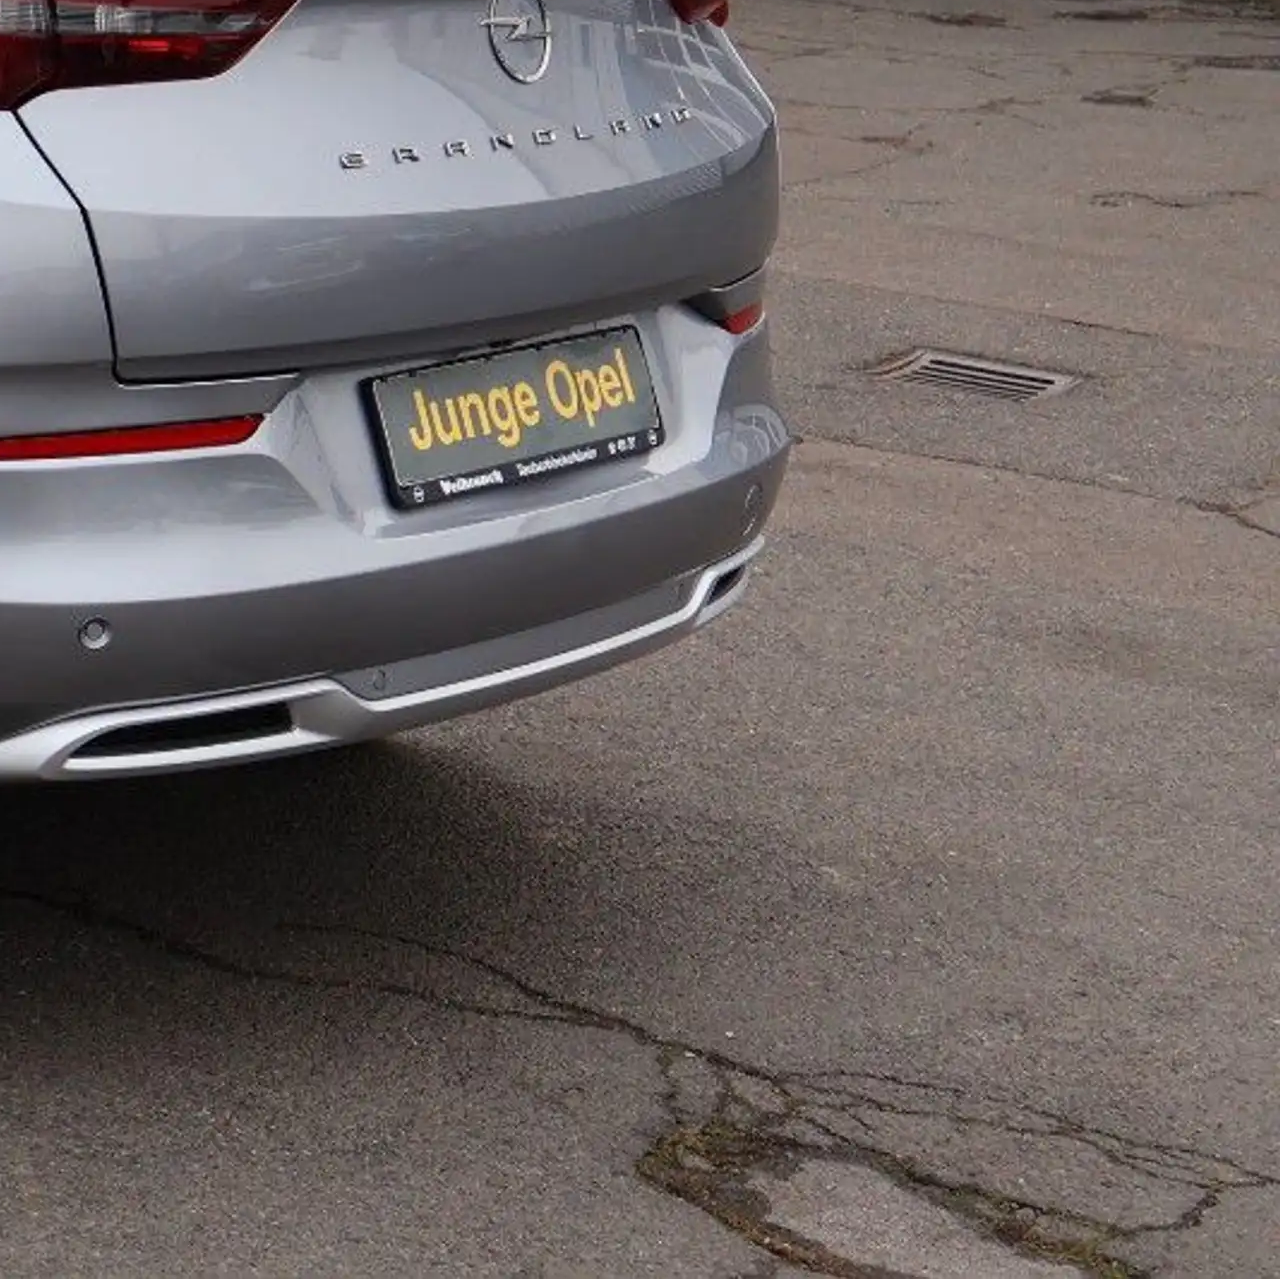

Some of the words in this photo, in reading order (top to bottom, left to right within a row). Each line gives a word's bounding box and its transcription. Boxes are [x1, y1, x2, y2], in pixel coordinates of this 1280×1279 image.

[339, 107, 691, 169] GRANDLAND
[408, 380, 540, 452] Junge
[545, 347, 636, 428] Opel
